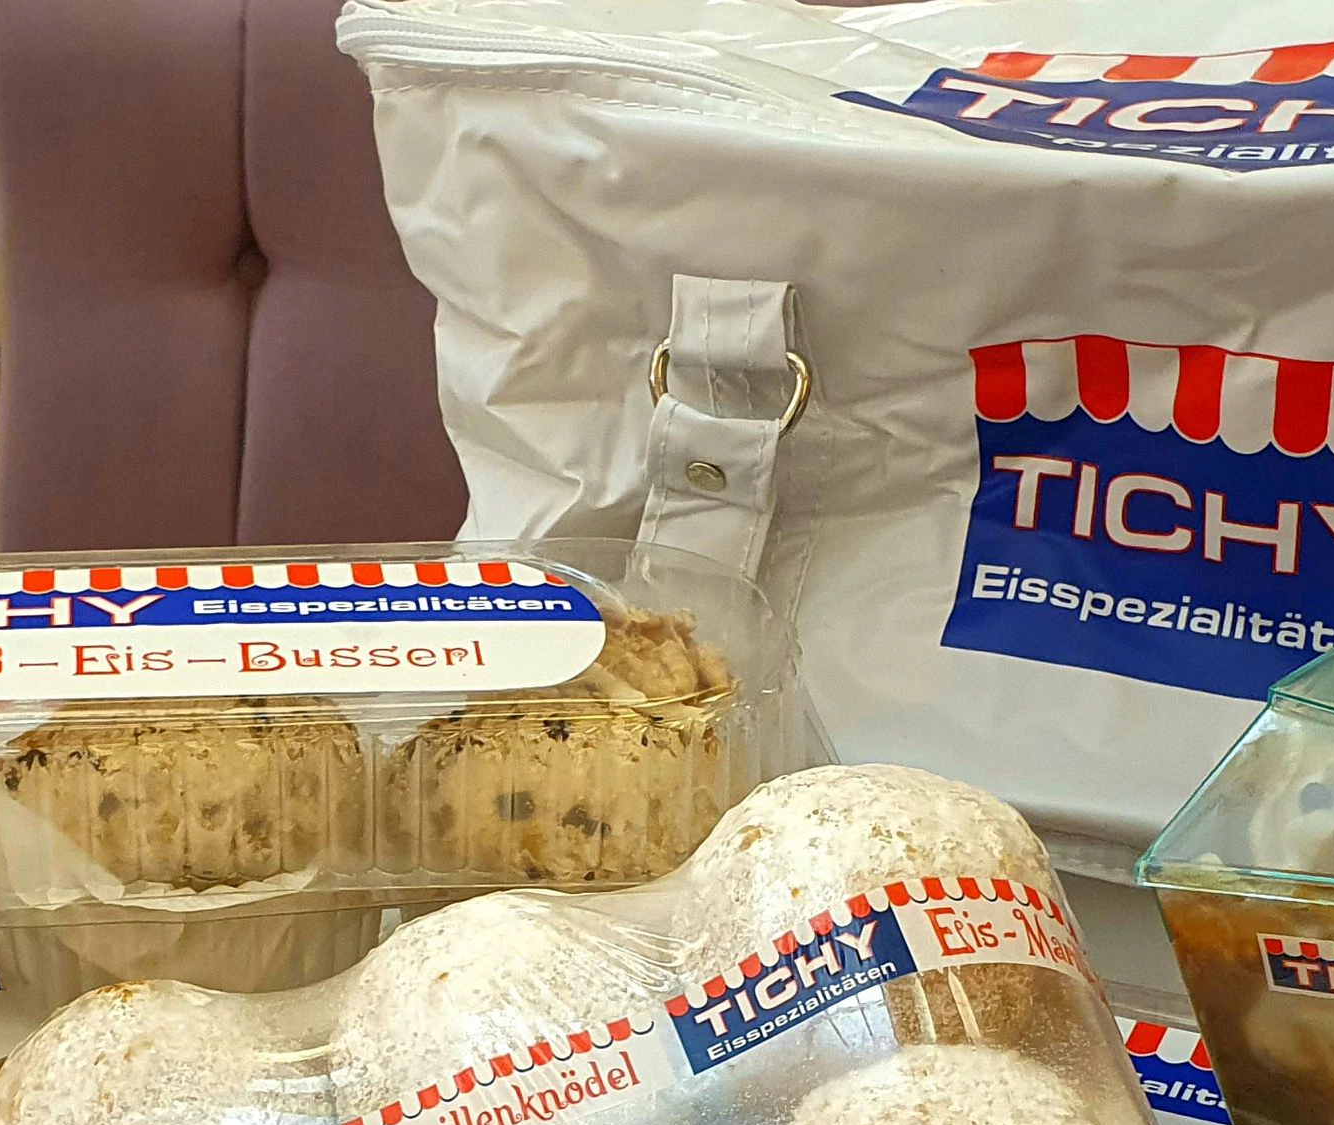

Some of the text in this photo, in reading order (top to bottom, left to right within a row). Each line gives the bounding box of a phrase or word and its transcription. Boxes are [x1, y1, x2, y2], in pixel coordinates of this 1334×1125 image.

[192, 592, 573, 618] Eisspezialitäten
[694, 919, 880, 1038] TICHY
[706, 958, 898, 1061] Eisspezialitäten
